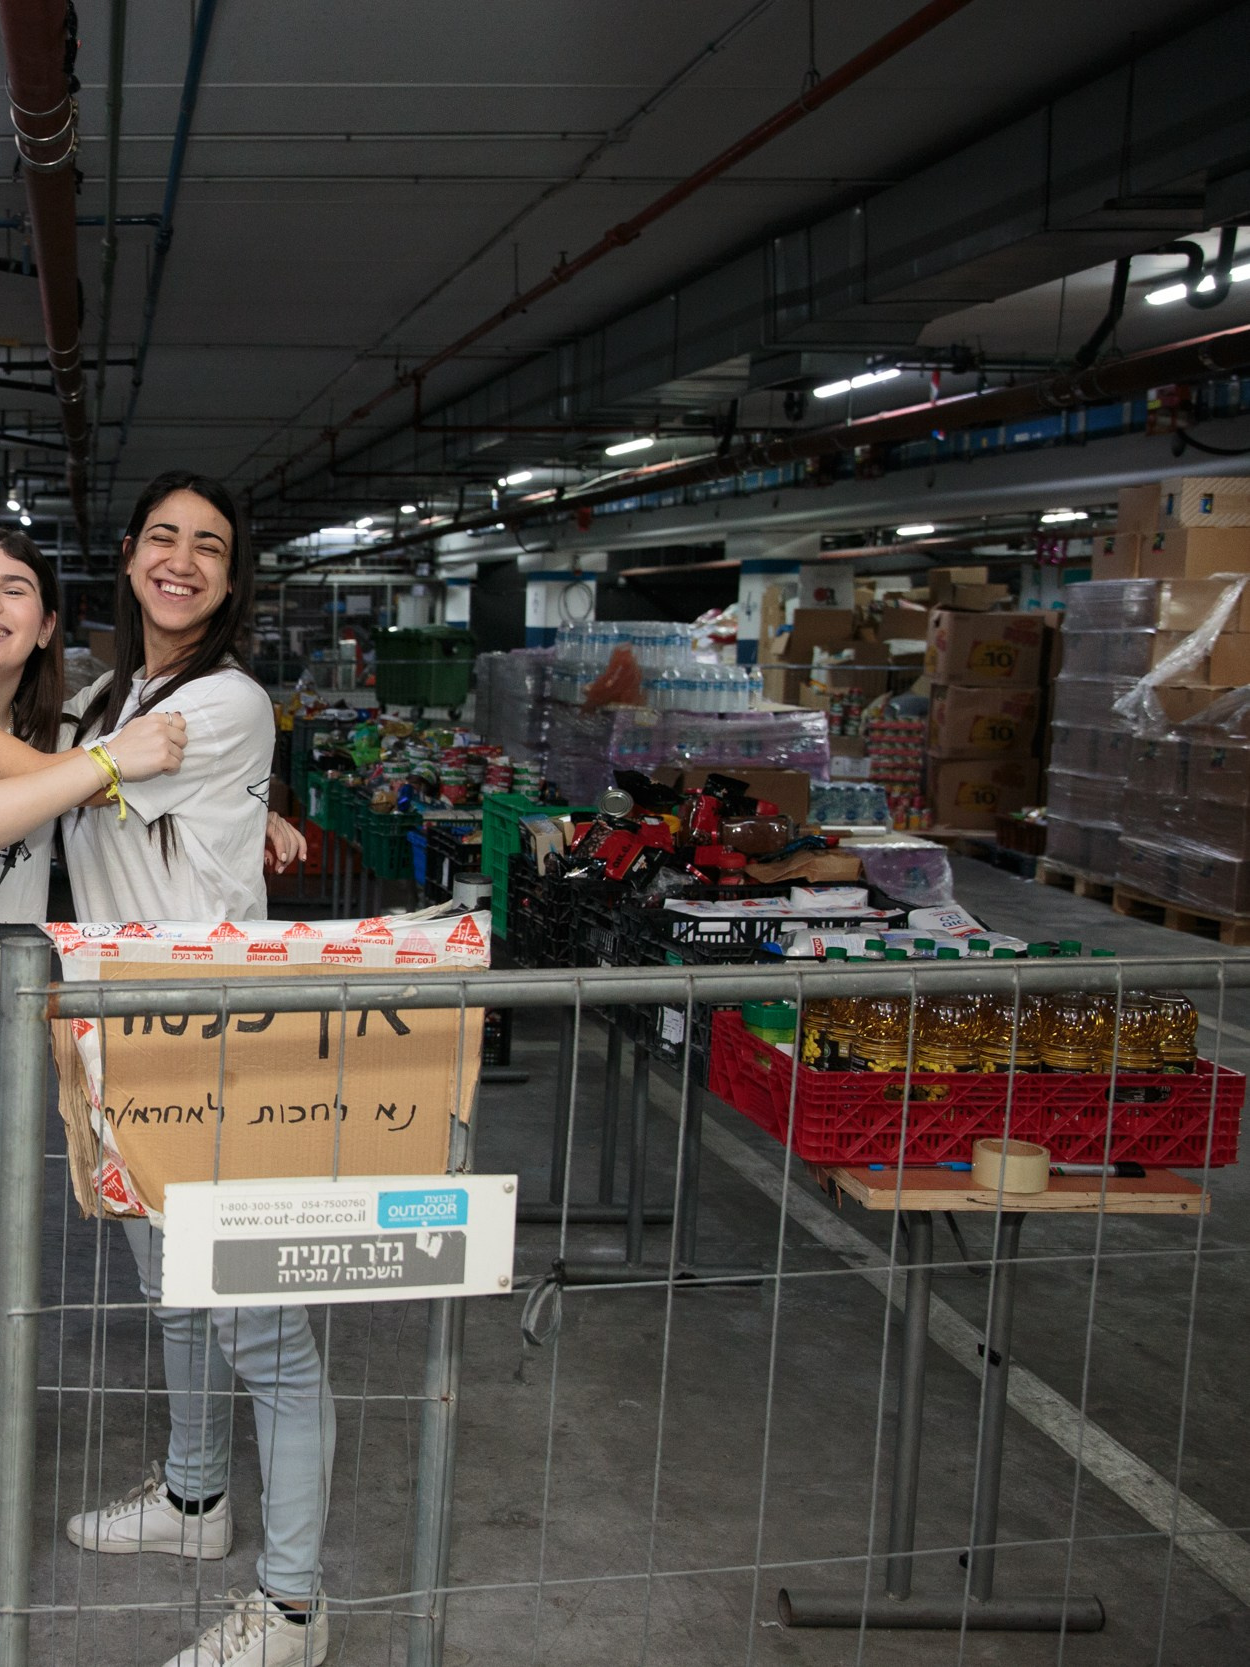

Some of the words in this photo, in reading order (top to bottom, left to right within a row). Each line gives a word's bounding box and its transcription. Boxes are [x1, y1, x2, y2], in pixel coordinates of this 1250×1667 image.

[985, 652, 1013, 668] 10
[989, 725, 1014, 742] 10
[971, 790, 996, 805] 10
[455, 922, 480, 943] Sika
[192, 952, 214, 960] גילאר
[246, 953, 288, 962] gilar.co.il
[342, 955, 363, 963] גילאר
[395, 955, 437, 965] gilar.co.il
[248, 1093, 348, 1125] לחכות
[376, 1102, 417, 1131] נא
[220, 1201, 293, 1211] 1-800-300-550
[301, 1198, 366, 1209] 054-7500760
[424, 1194, 457, 1204] קבוצת
[388, 1203, 457, 1217] OUTDOOR
[220, 1210, 366, 1227] www.out-door.co.il
[278, 1243, 353, 1267] זמנית
[363, 1240, 405, 1265] גדר
[278, 1268, 329, 1284] מכירה
[332, 1265, 341, 1282] /
[345, 1264, 403, 1281] השכרה
